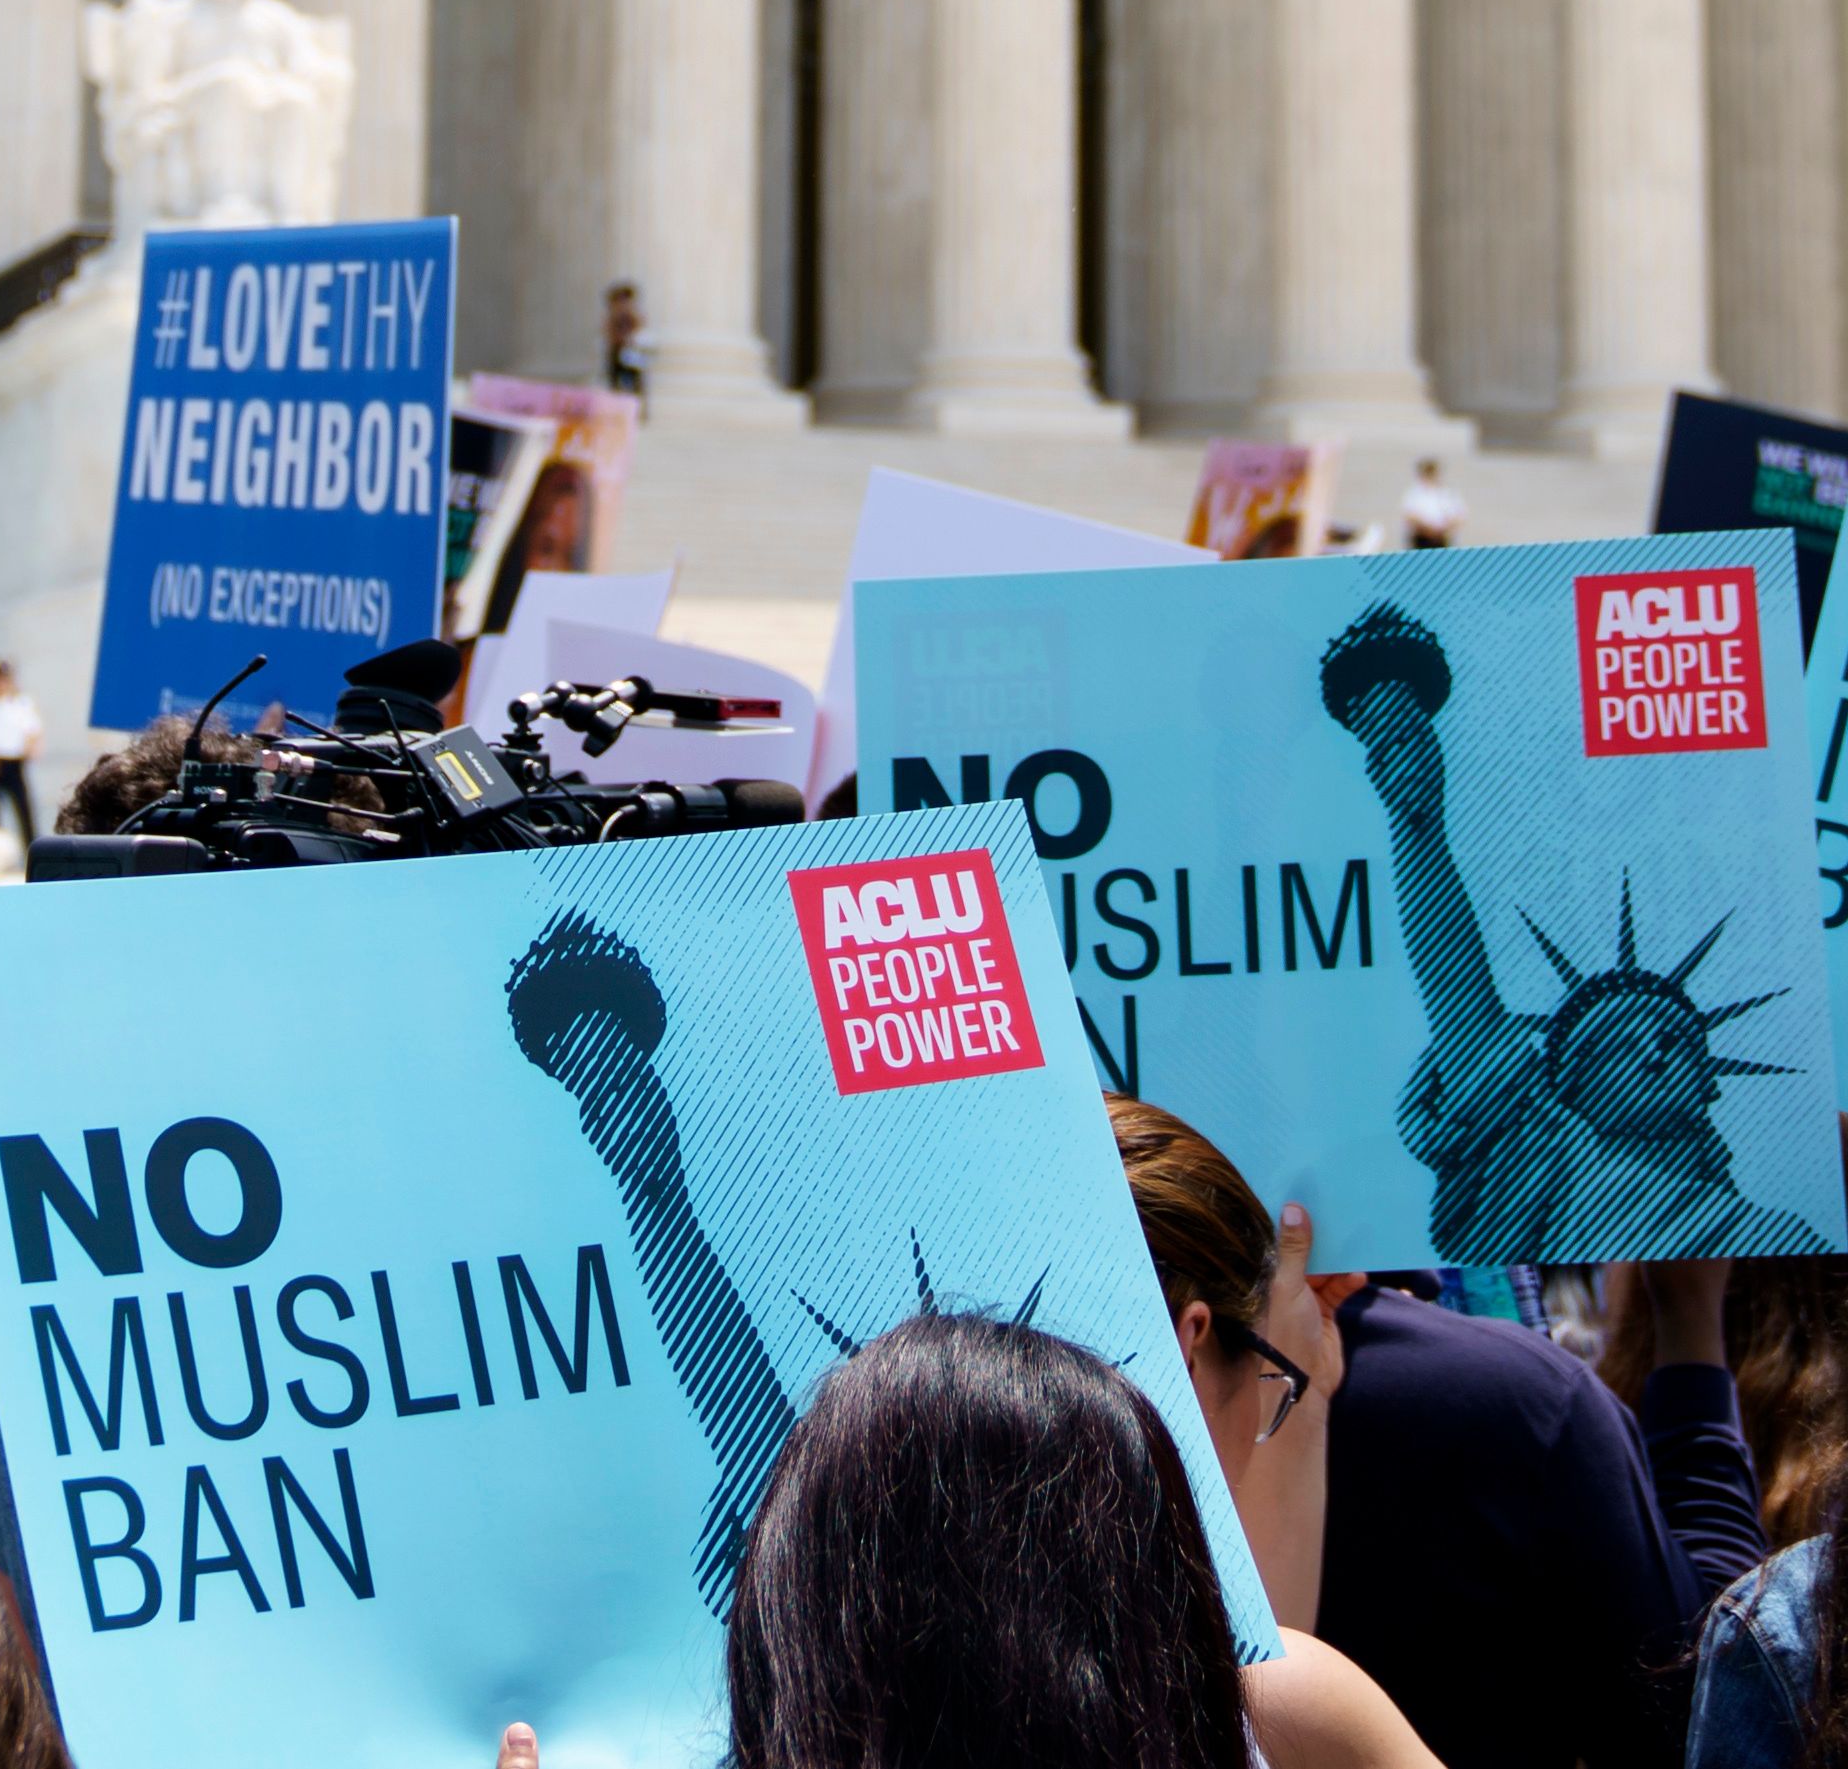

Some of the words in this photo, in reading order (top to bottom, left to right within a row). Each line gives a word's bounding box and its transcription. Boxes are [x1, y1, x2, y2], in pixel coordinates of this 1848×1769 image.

[128, 397, 435, 516] NEIGHBOR
[150, 562, 202, 628] (NO
[209, 565, 391, 650] EXCEPTIONS)
[1595, 582, 1741, 641] ACLU
[1595, 639, 1746, 691] PEOPLE
[1598, 689, 1750, 741] POWER
[822, 870, 984, 950] ACLU
[827, 937, 1004, 1011] PEOPLE
[842, 999, 1021, 1073] POWER
[29, 1242, 632, 1457] MUSLIM
[62, 1448, 377, 1634] BAN
